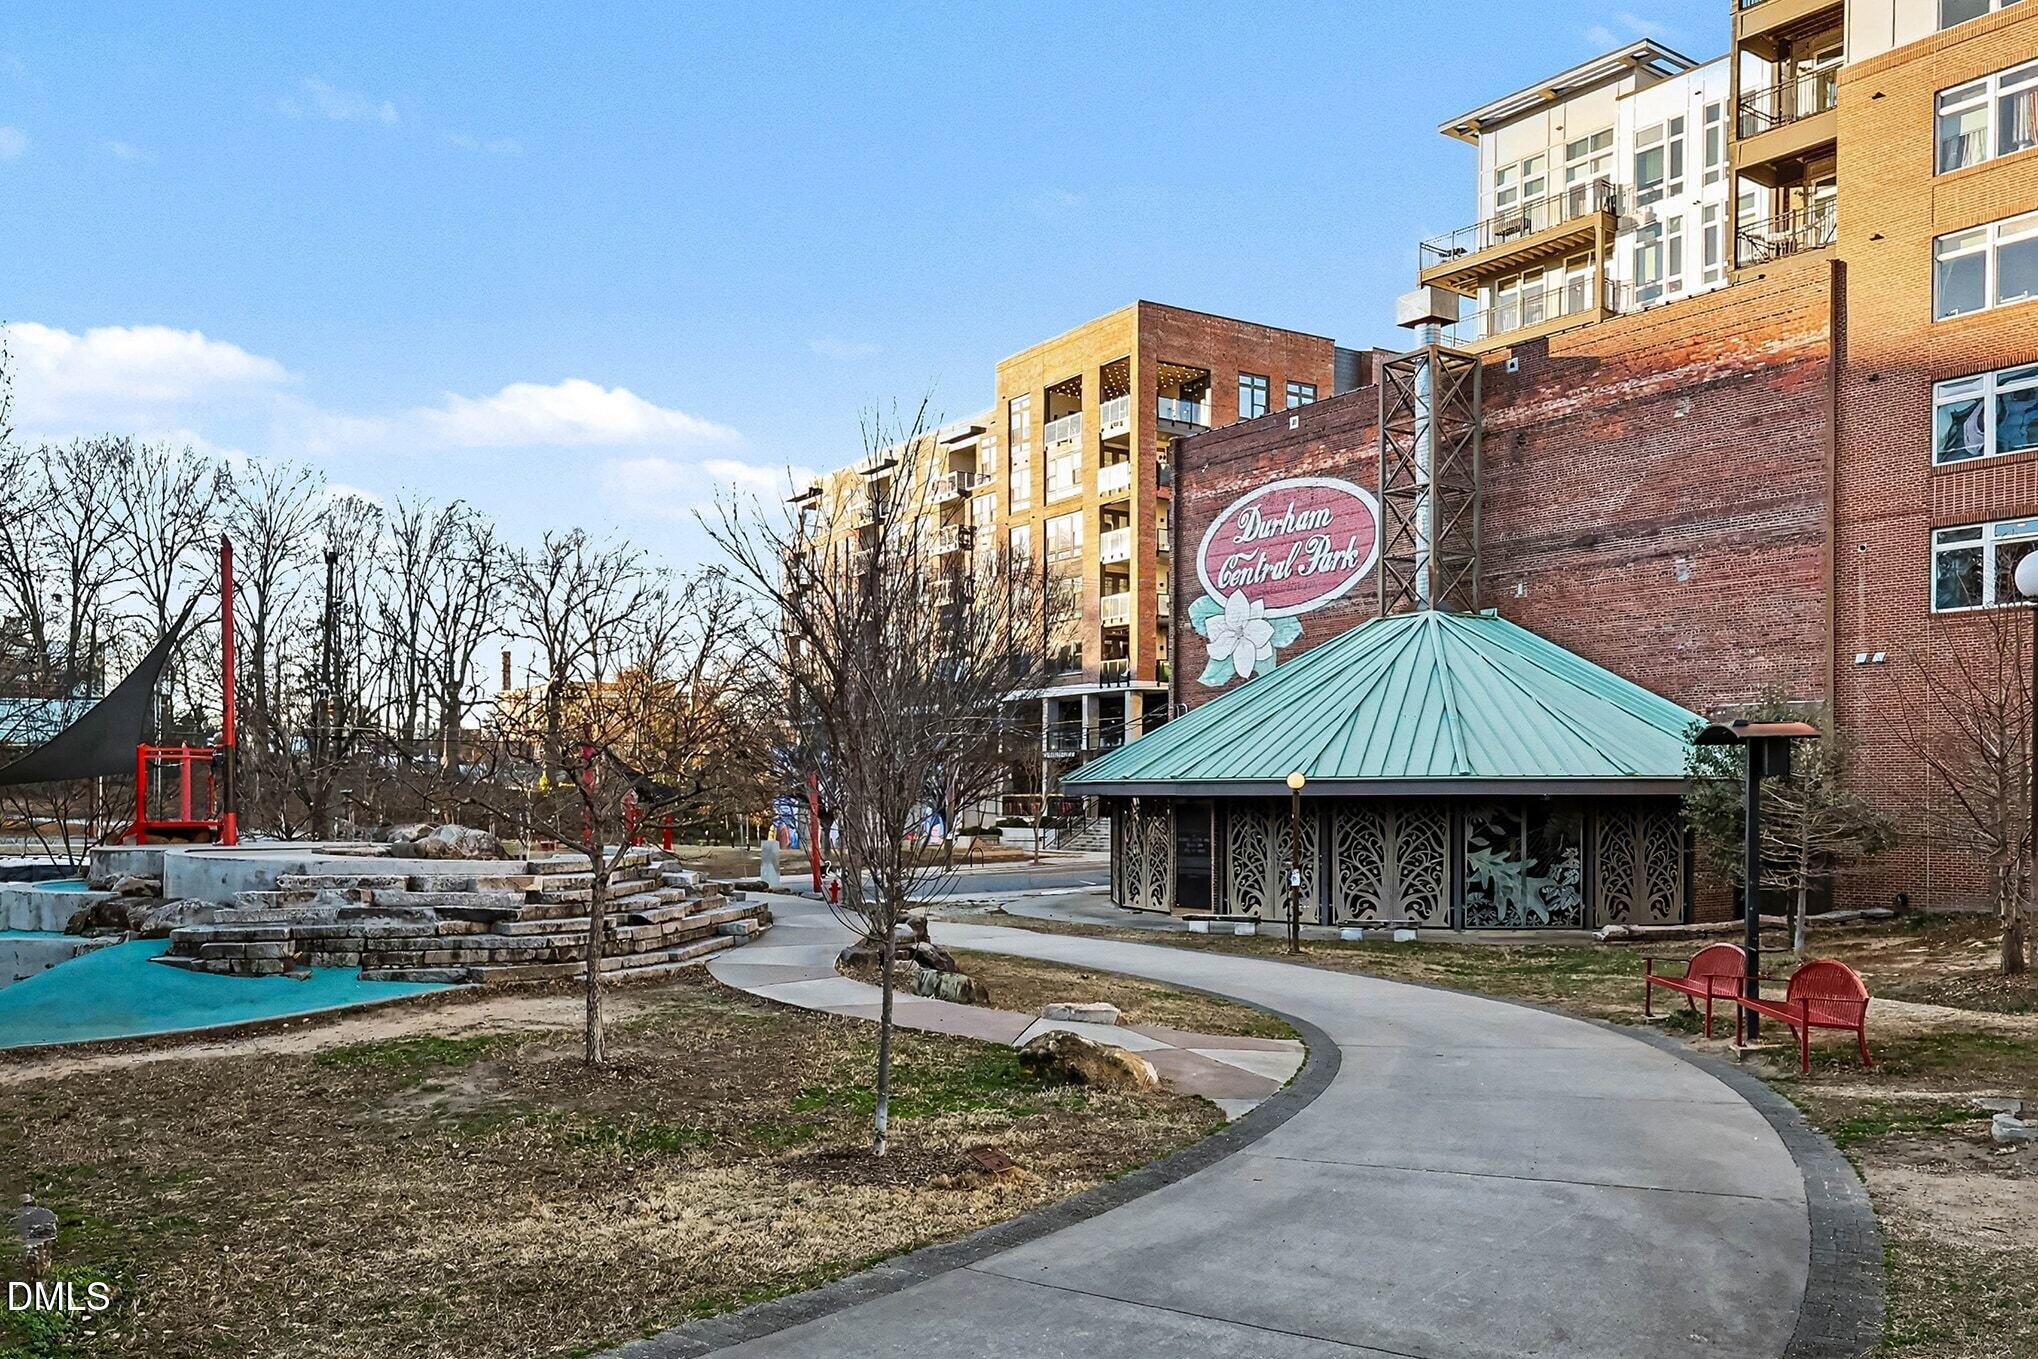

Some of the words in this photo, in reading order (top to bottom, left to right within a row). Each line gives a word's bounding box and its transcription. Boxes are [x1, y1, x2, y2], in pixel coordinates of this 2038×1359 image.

[1233, 501, 1334, 544] Durham
[1217, 541, 1302, 590] Central
[1298, 534, 1359, 576] Park
